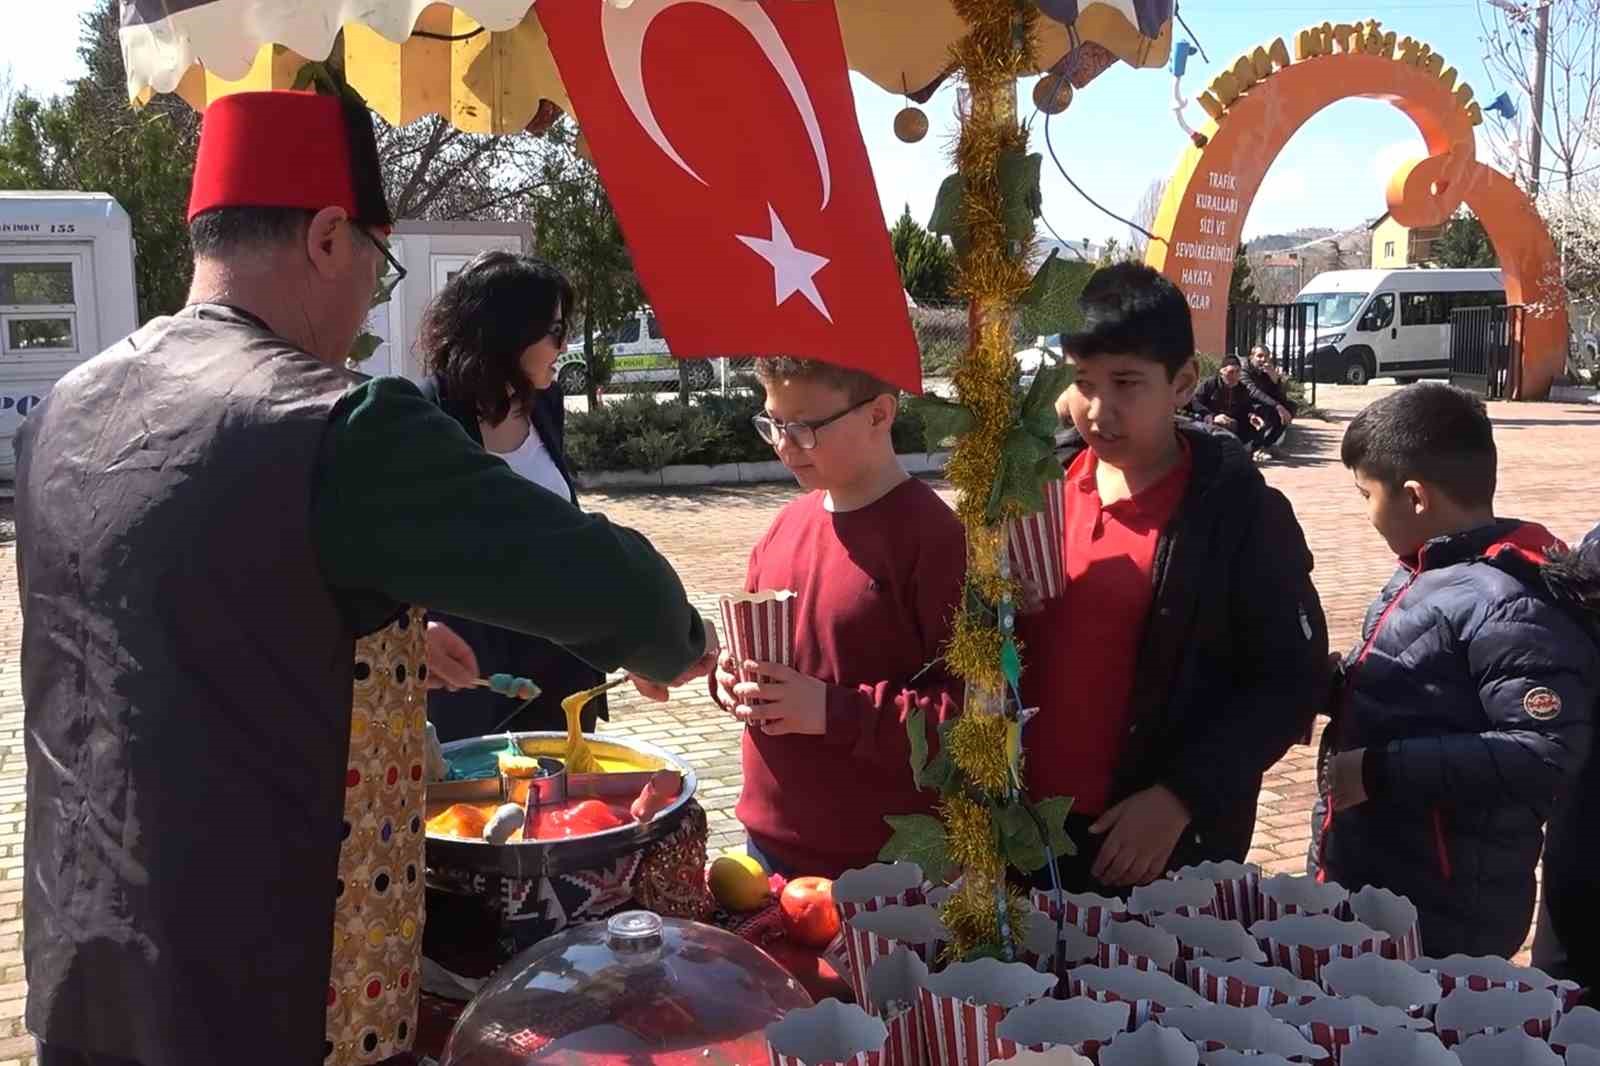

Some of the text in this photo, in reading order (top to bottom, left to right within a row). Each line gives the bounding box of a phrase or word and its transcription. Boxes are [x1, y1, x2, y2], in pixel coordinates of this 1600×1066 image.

[1208, 171, 1238, 191] TRAFİK
[1195, 193, 1239, 214] KURALLARI
[50, 224, 75, 233] 155
[1182, 268, 1213, 287] HAYATA
[1186, 292, 1211, 310] AĞLAR
